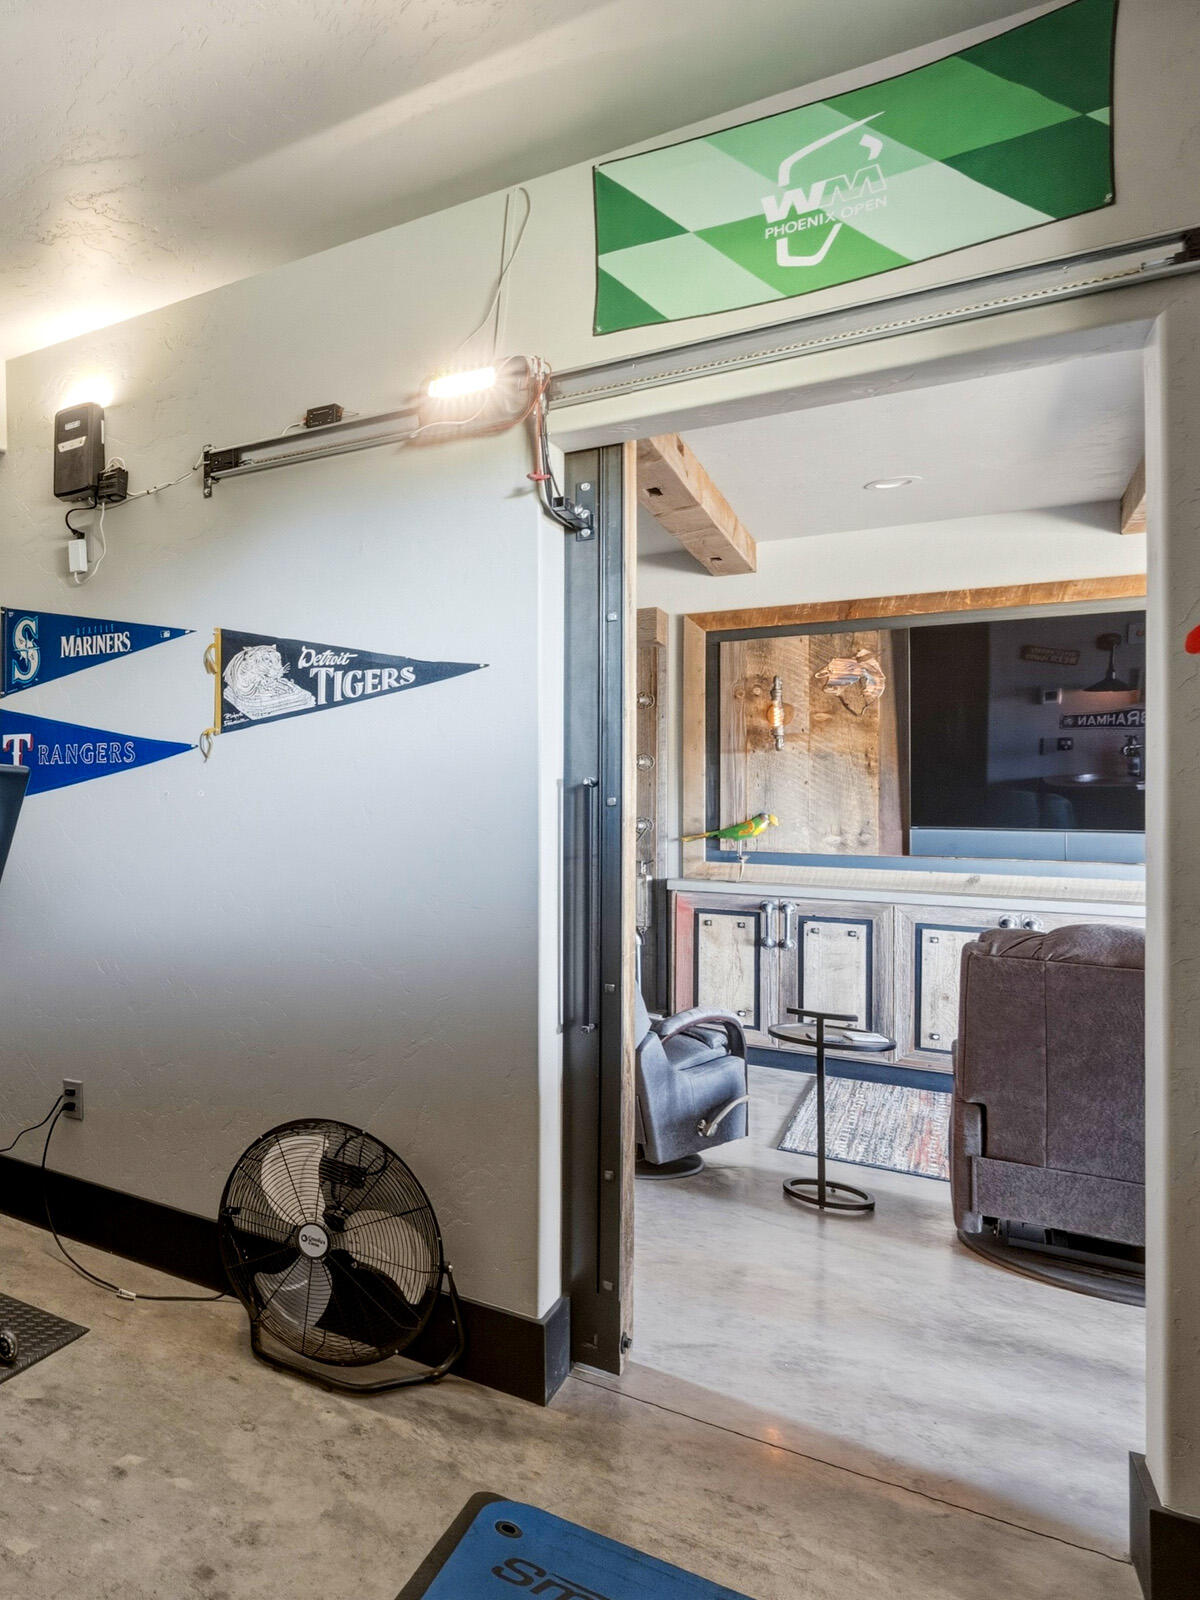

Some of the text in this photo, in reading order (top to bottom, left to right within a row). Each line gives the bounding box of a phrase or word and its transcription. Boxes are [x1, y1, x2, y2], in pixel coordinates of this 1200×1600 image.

[764, 195, 888, 240] PHOENIX OPEN
[60, 631, 132, 659] MARINERS
[298, 645, 358, 669] Detroit
[309, 666, 417, 706] TIGERS
[37, 741, 137, 766] RANGERS
